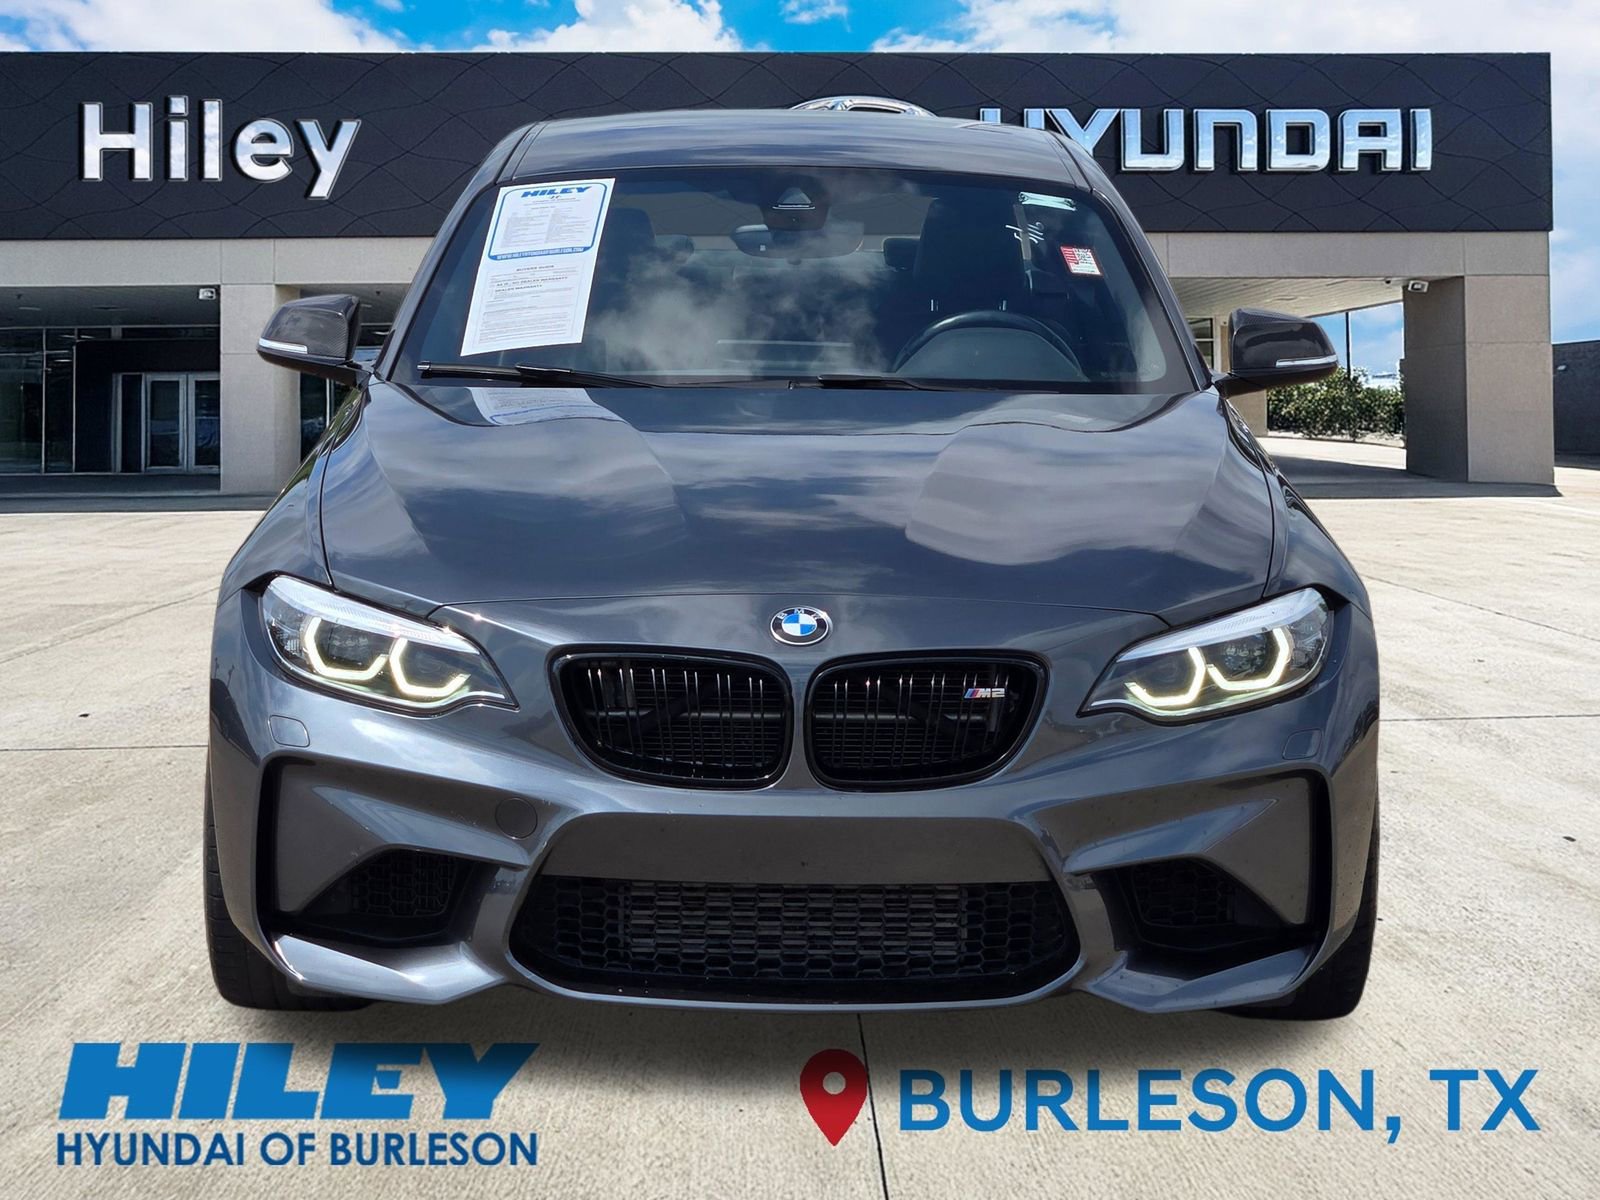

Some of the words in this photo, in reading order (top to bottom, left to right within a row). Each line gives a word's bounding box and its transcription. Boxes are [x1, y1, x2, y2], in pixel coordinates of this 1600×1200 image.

[81, 95, 361, 200] Hiley
[521, 186, 591, 197] HILEY
[777, 607, 822, 621] BMW
